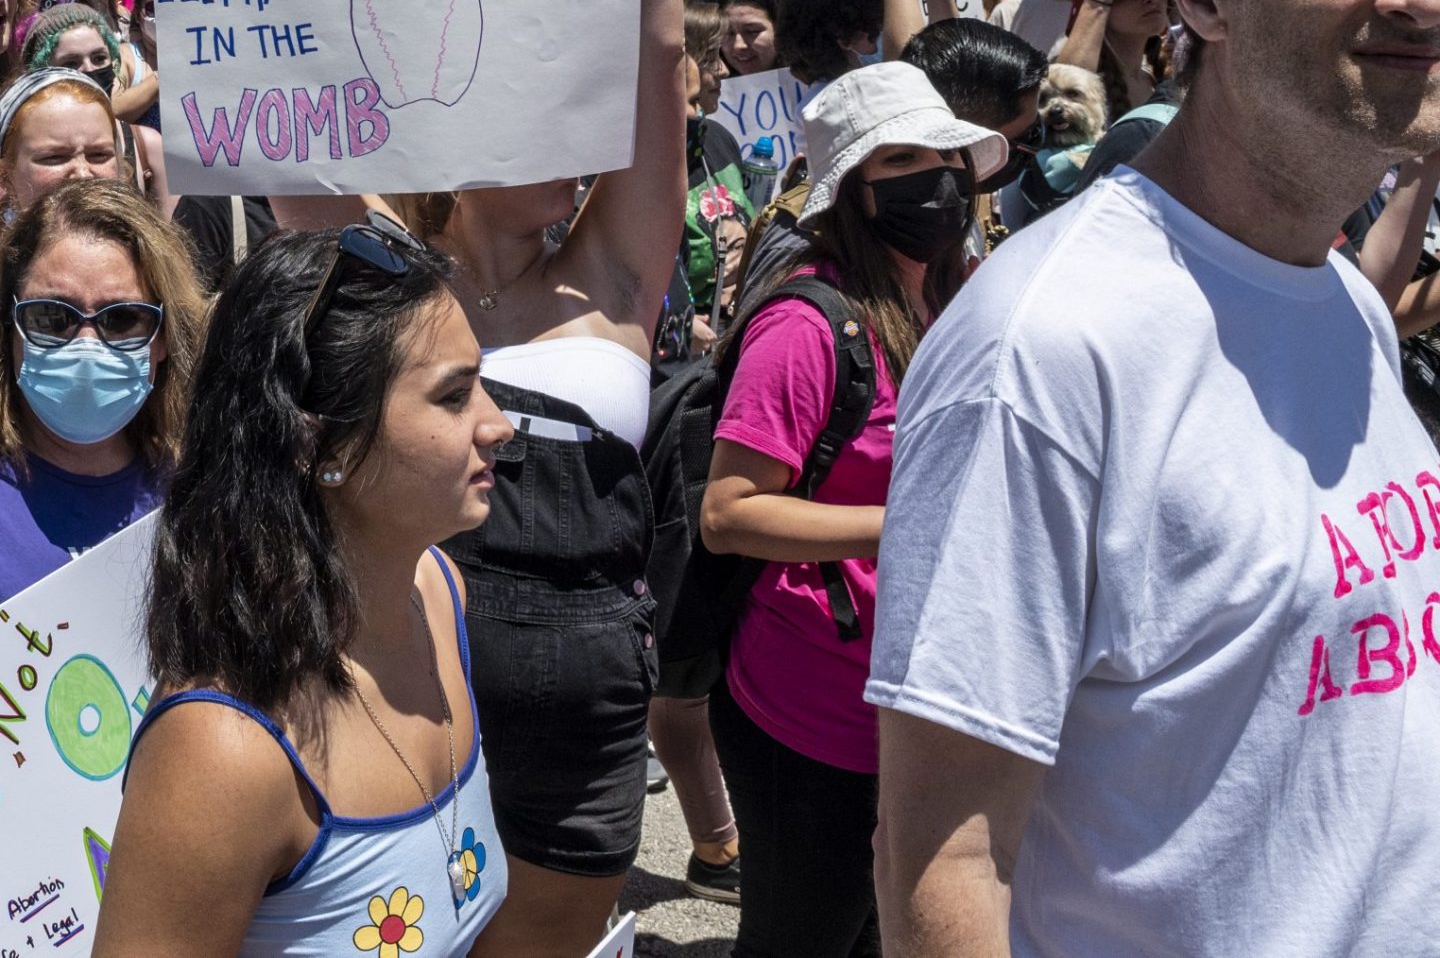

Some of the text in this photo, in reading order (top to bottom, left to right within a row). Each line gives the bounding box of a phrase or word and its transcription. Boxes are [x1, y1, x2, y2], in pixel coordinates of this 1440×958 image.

[185, 23, 318, 65] IN THE
[180, 78, 391, 168] WOMB
[7, 876, 65, 920] Abortion
[43, 907, 79, 939] Legal
